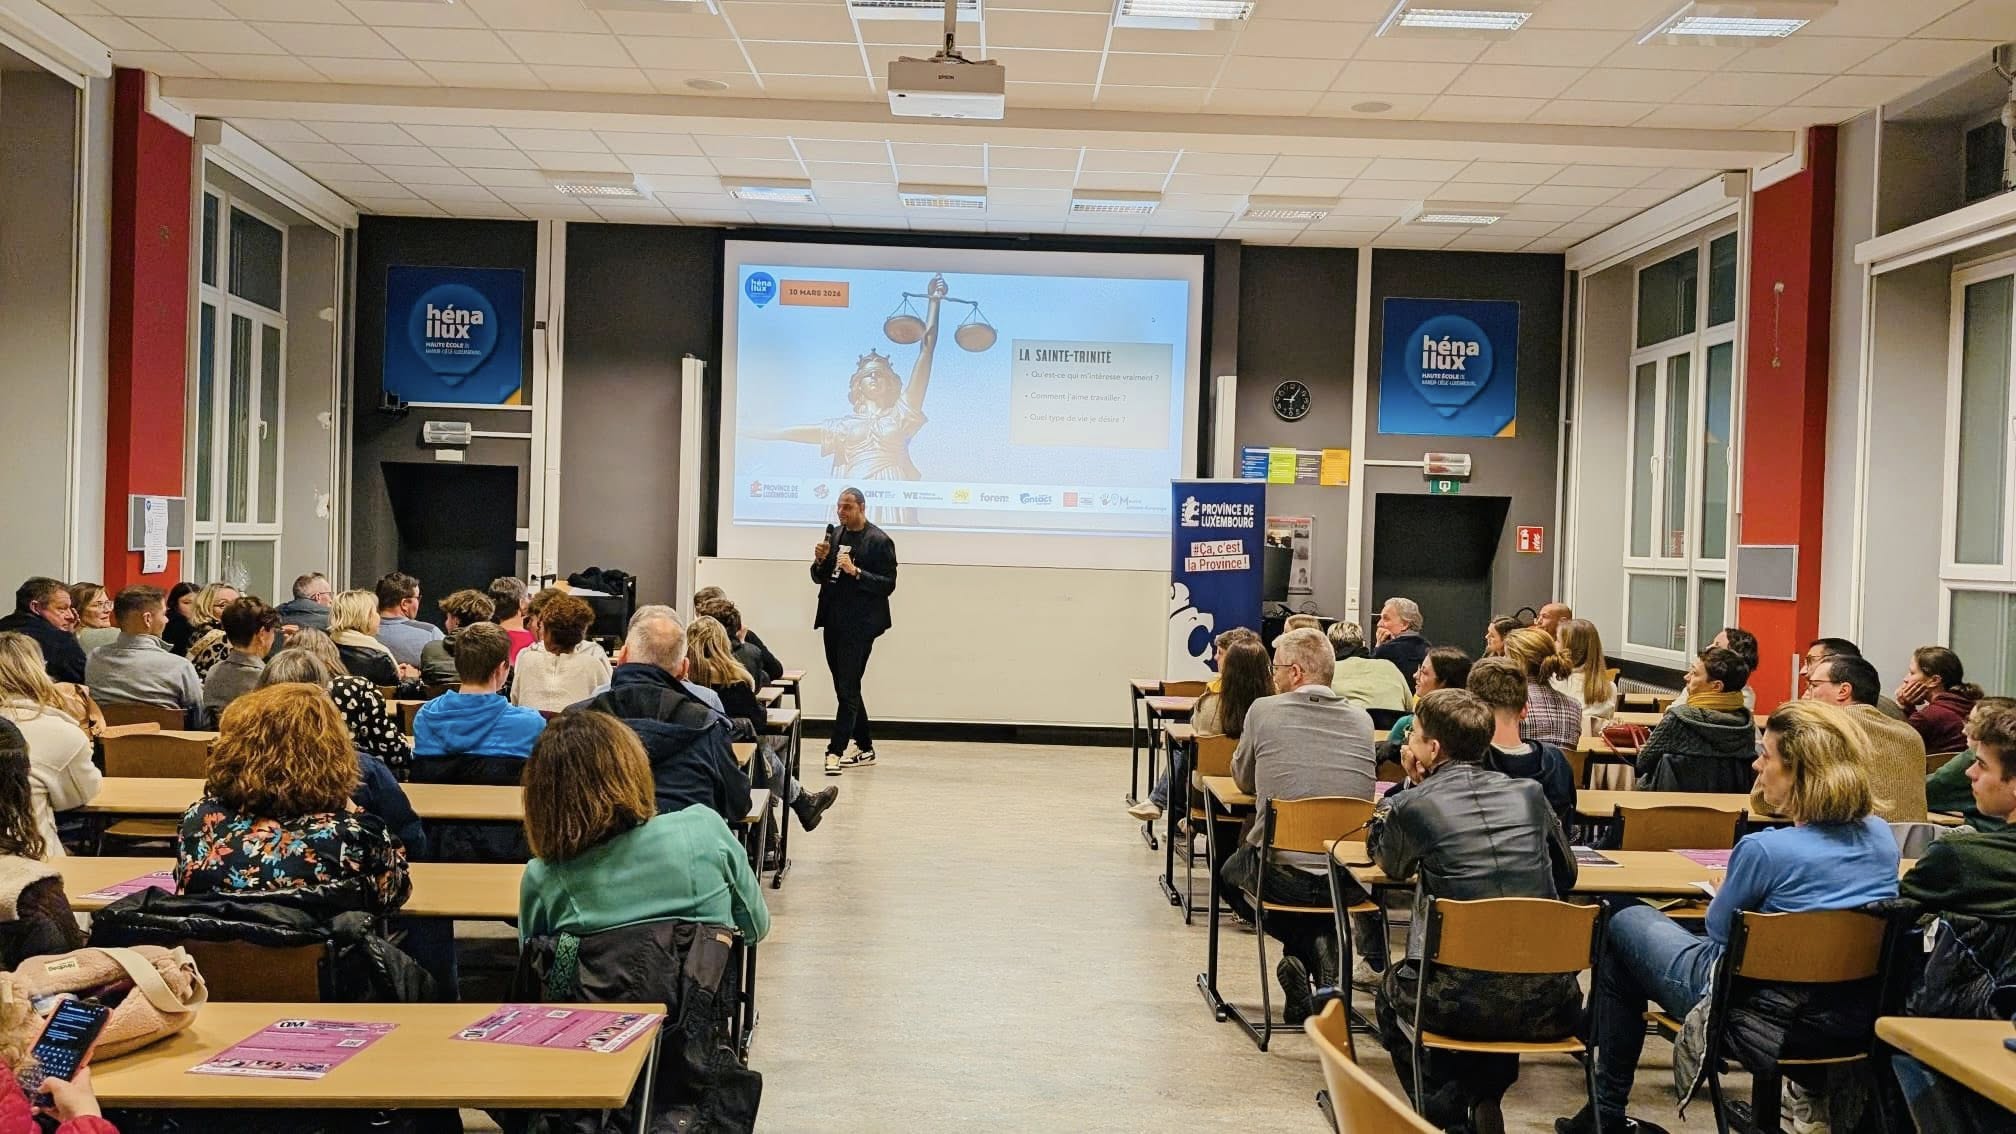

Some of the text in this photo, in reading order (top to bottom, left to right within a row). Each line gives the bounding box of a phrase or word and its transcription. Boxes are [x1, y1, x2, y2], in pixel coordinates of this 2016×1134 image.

[800, 289, 822, 297] MARS
[426, 303, 484, 325] héna
[426, 320, 470, 339] llux
[1423, 335, 1480, 356] héna
[1019, 348, 1030, 361] LA
[1422, 351, 1466, 370] llux
[1067, 372, 1079, 381] qui
[1122, 372, 1154, 382] vraiment
[1030, 392, 1066, 400] Comment
[1067, 391, 1089, 402] j'aime
[1090, 393, 1121, 402] travailler
[1029, 413, 1048, 421] Quel
[1049, 415, 1065, 424] type
[1066, 414, 1077, 422] de
[1078, 414, 1088, 422] vie
[1089, 415, 1097, 424] je
[1098, 415, 1120, 423] désire
[980, 492, 1009, 502] forem
[1202, 502, 1254, 516] PROVINCE DE
[1201, 515, 1254, 528] LUXEMBOURG
[1217, 541, 1241, 554] c'est
[1187, 558, 1197, 571] la
[1200, 556, 1242, 570] Province
